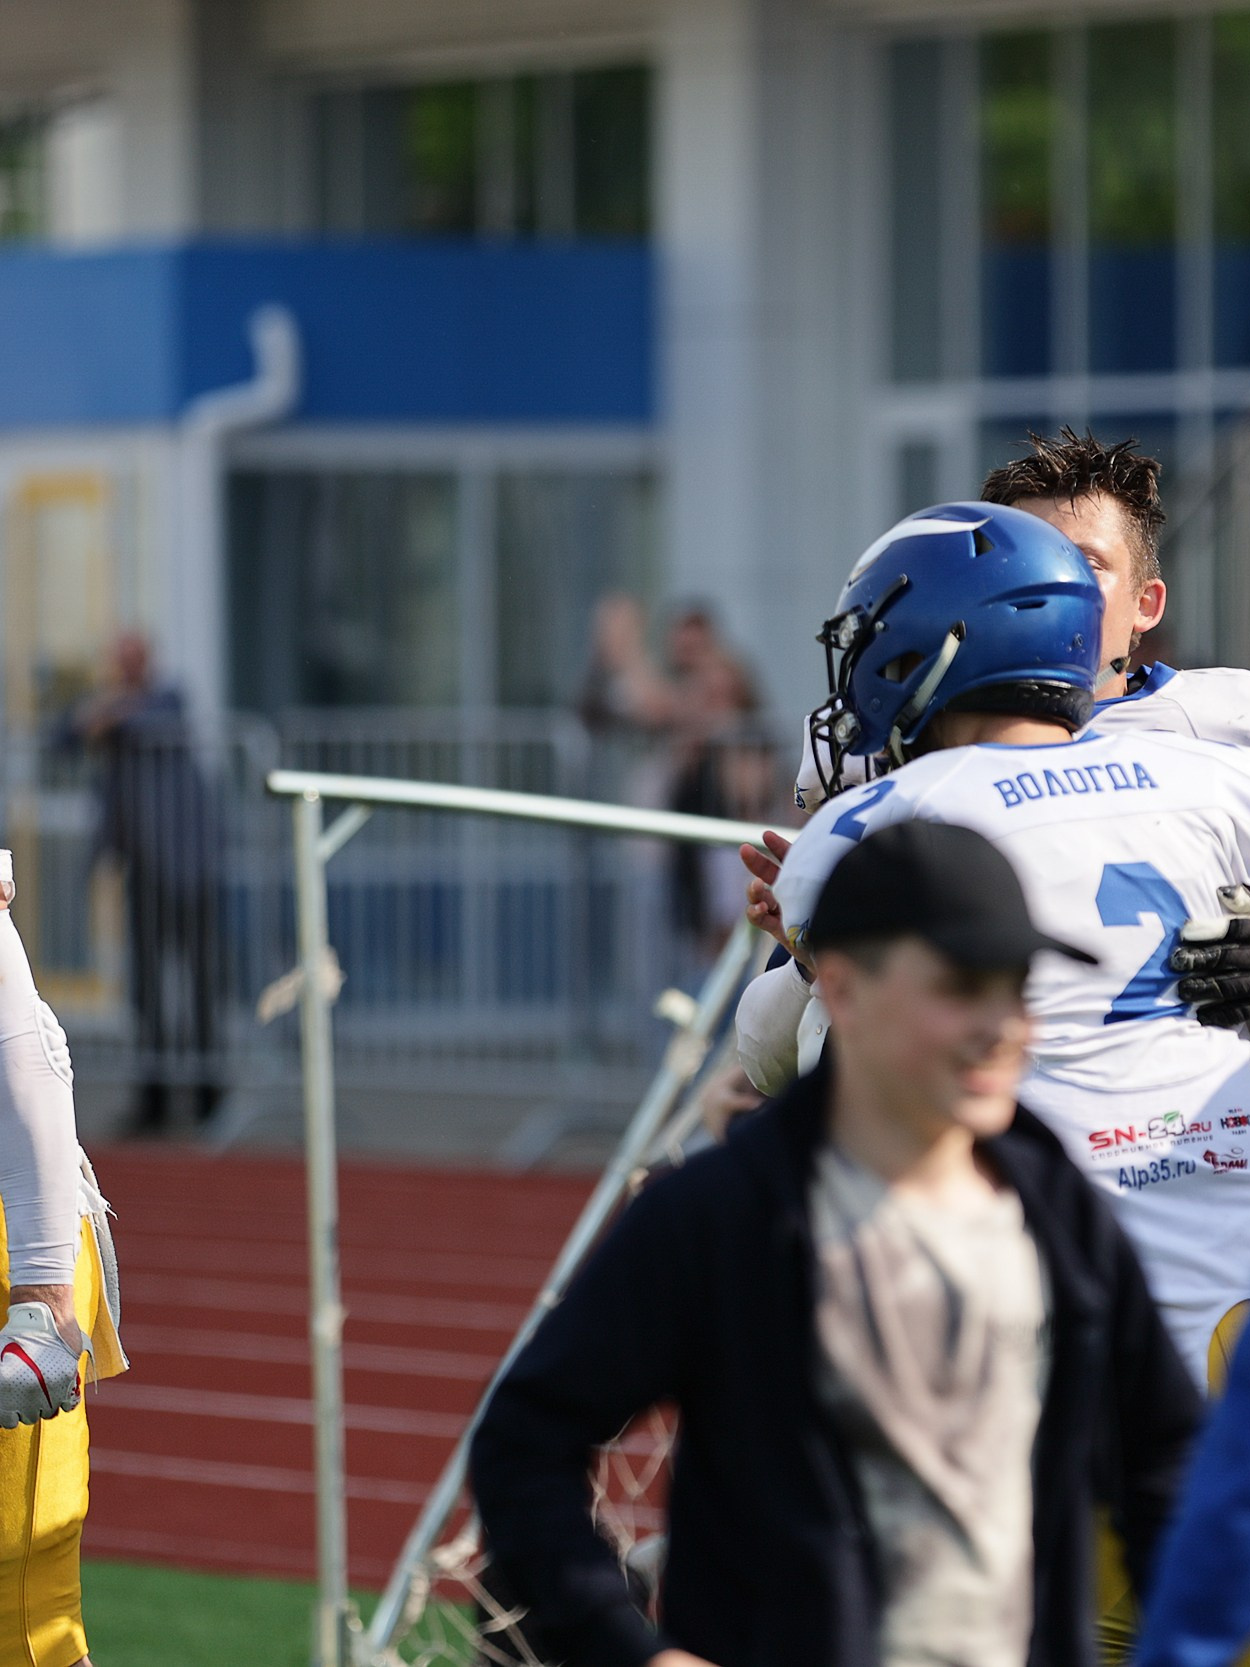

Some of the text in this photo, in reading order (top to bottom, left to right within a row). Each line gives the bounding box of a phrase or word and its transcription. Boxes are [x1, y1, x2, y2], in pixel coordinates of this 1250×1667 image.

[830, 780, 896, 843] 2
[993, 762, 1158, 808] ВОЛОГДА
[1095, 862, 1192, 1025] 2
[1119, 1158, 1196, 1190] Alp35.ru
